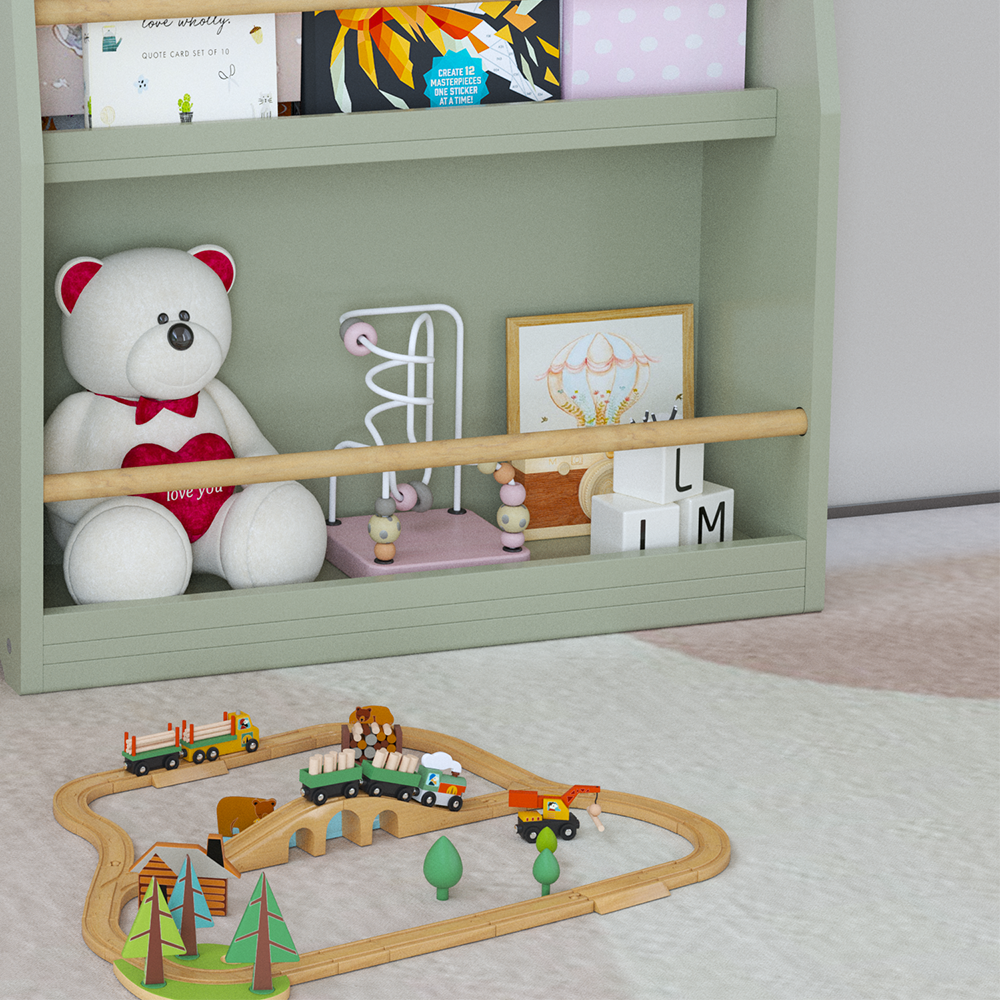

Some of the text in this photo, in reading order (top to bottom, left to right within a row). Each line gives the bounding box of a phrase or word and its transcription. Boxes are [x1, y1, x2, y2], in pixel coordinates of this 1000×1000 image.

[142, 51, 167, 59] QUOTE
[170, 50, 190, 58] CARD
[193, 49, 205, 57] SET
[438, 66, 475, 77] CREATE 12
[430, 76, 481, 87] MASTERPIECES
[434, 86, 478, 97] ONE STICKER
[439, 96, 473, 105] AT A TIME!
[676, 448, 692, 492] L
[196, 486, 223, 501] you
[698, 501, 725, 544] M
